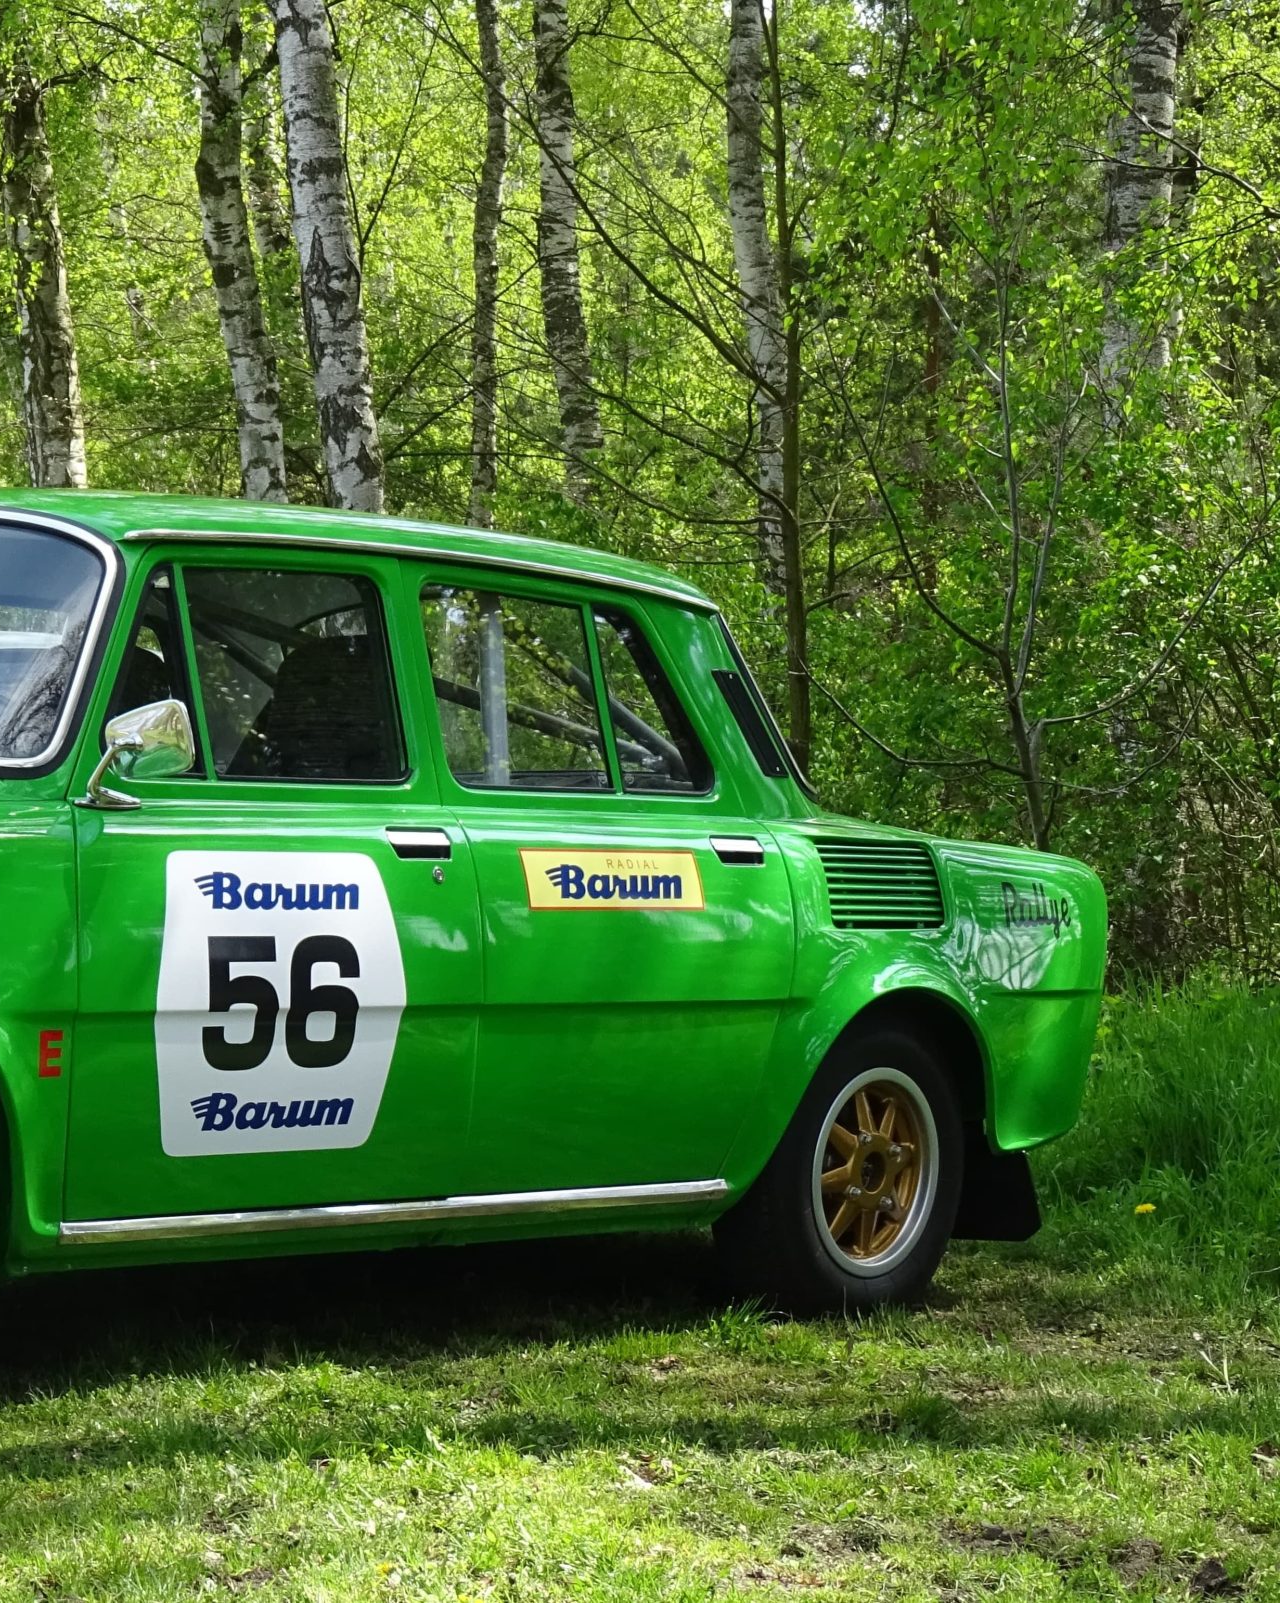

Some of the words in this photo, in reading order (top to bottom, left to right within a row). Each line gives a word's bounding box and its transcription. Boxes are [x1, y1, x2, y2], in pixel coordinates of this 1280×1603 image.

[545, 864, 682, 900] Barum
[606, 858, 659, 870] RADIAL
[194, 871, 360, 911] Barum
[1001, 881, 1071, 939] Rallye
[202, 934, 361, 1071] 56
[38, 1030, 64, 1077] E
[190, 1092, 355, 1132] Barum
